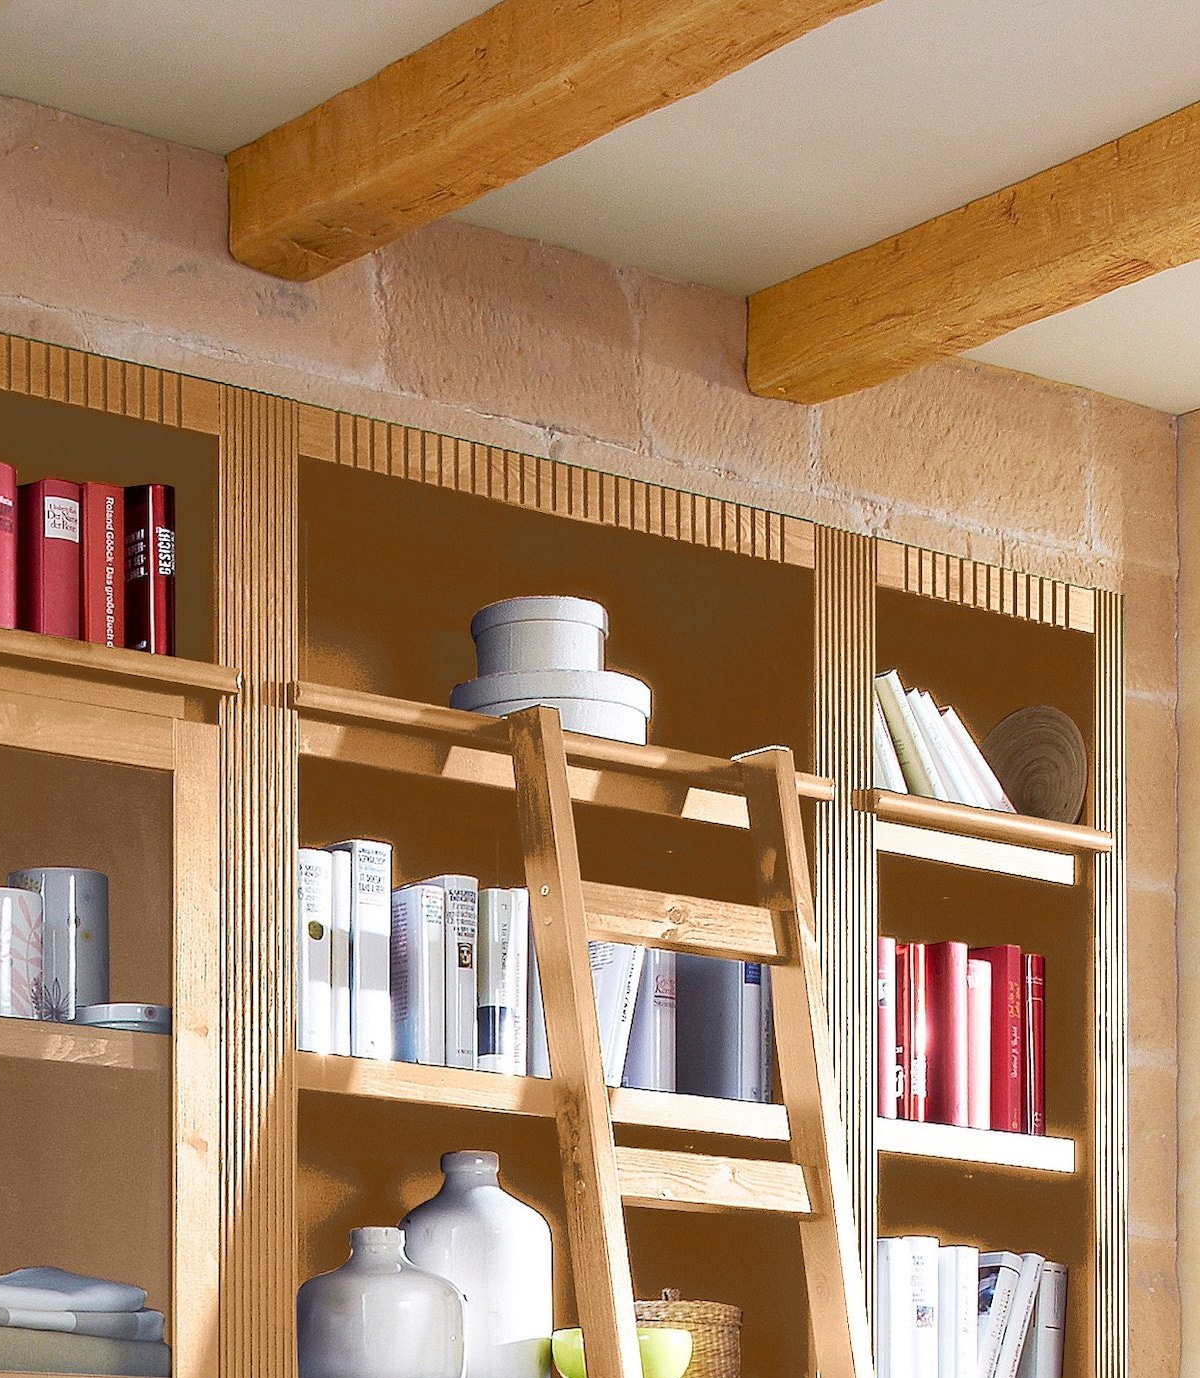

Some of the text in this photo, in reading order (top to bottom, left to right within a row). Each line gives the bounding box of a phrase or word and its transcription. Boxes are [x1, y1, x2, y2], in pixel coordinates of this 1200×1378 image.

[106, 497, 115, 531] Roland
[157, 527, 172, 576] GESICHT
[106, 566, 115, 584] Das
